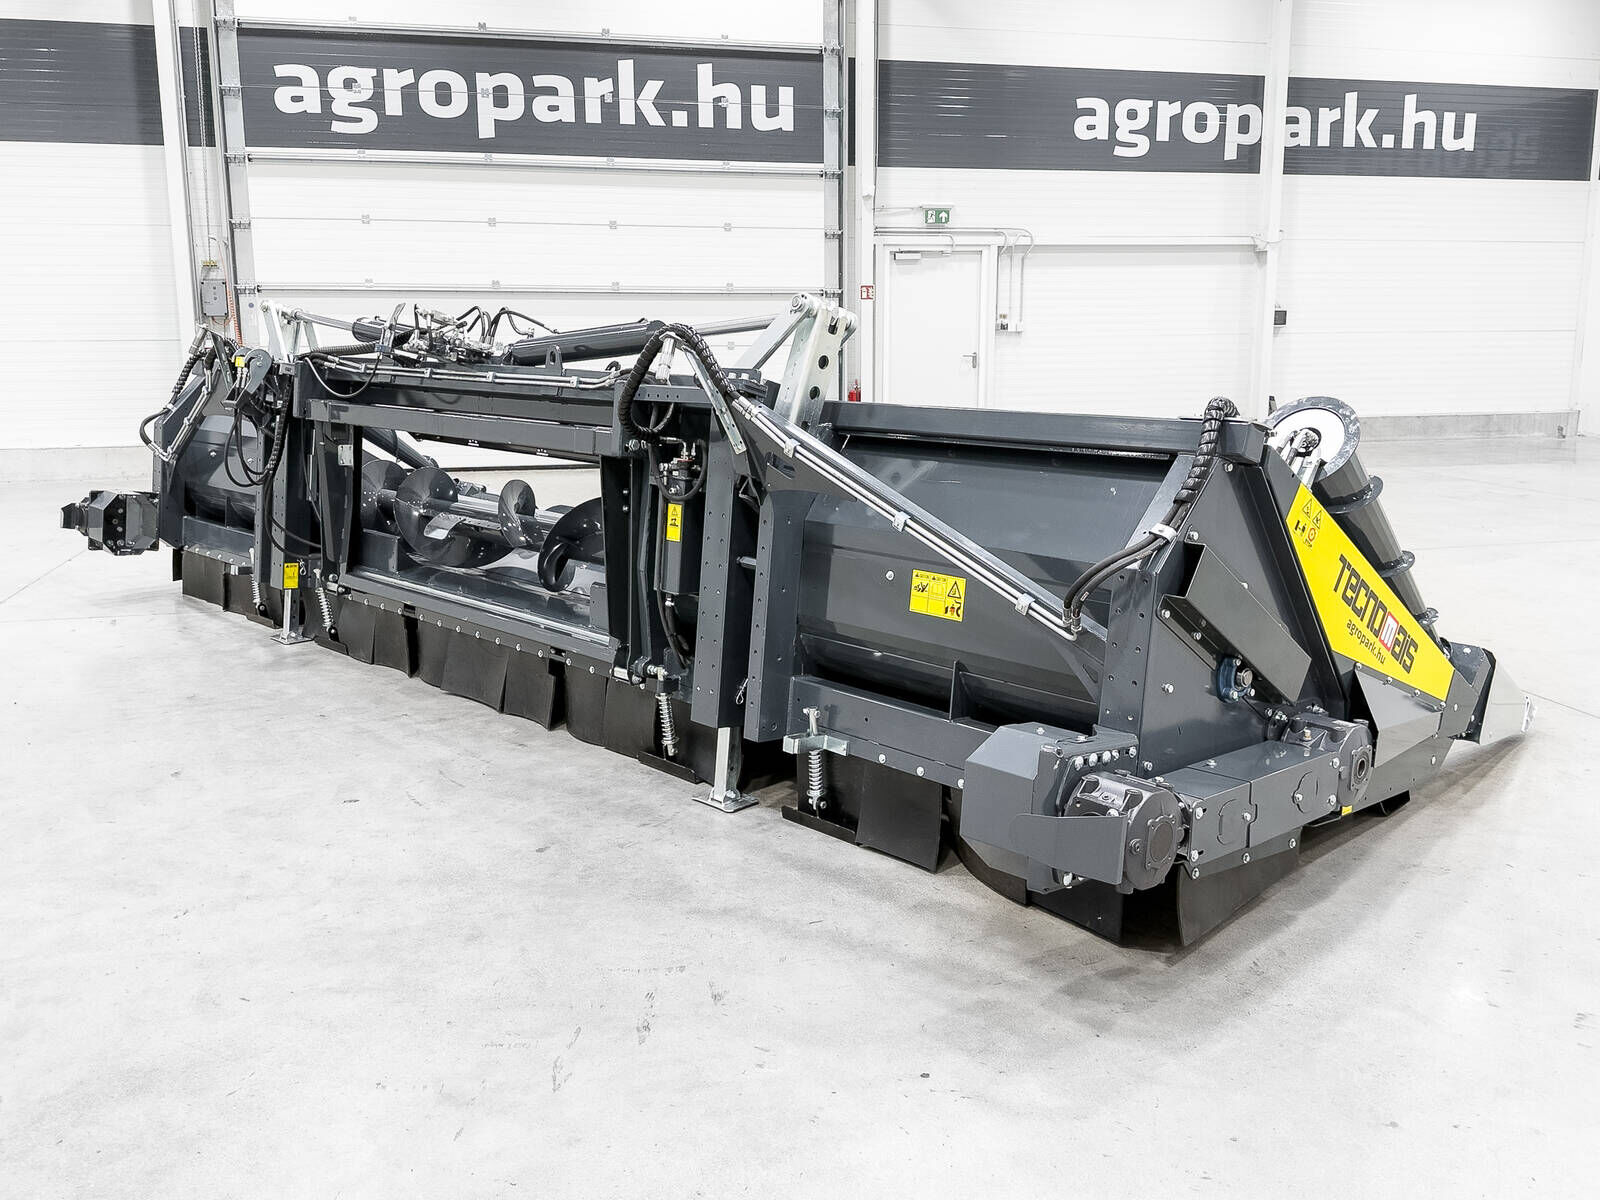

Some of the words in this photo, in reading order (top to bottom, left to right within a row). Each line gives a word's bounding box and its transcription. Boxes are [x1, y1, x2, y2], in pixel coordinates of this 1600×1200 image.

[273, 59, 795, 139] agropark.hu
[1073, 91, 1477, 161] agropark.hu
[1346, 619, 1386, 665] agropark.hu
